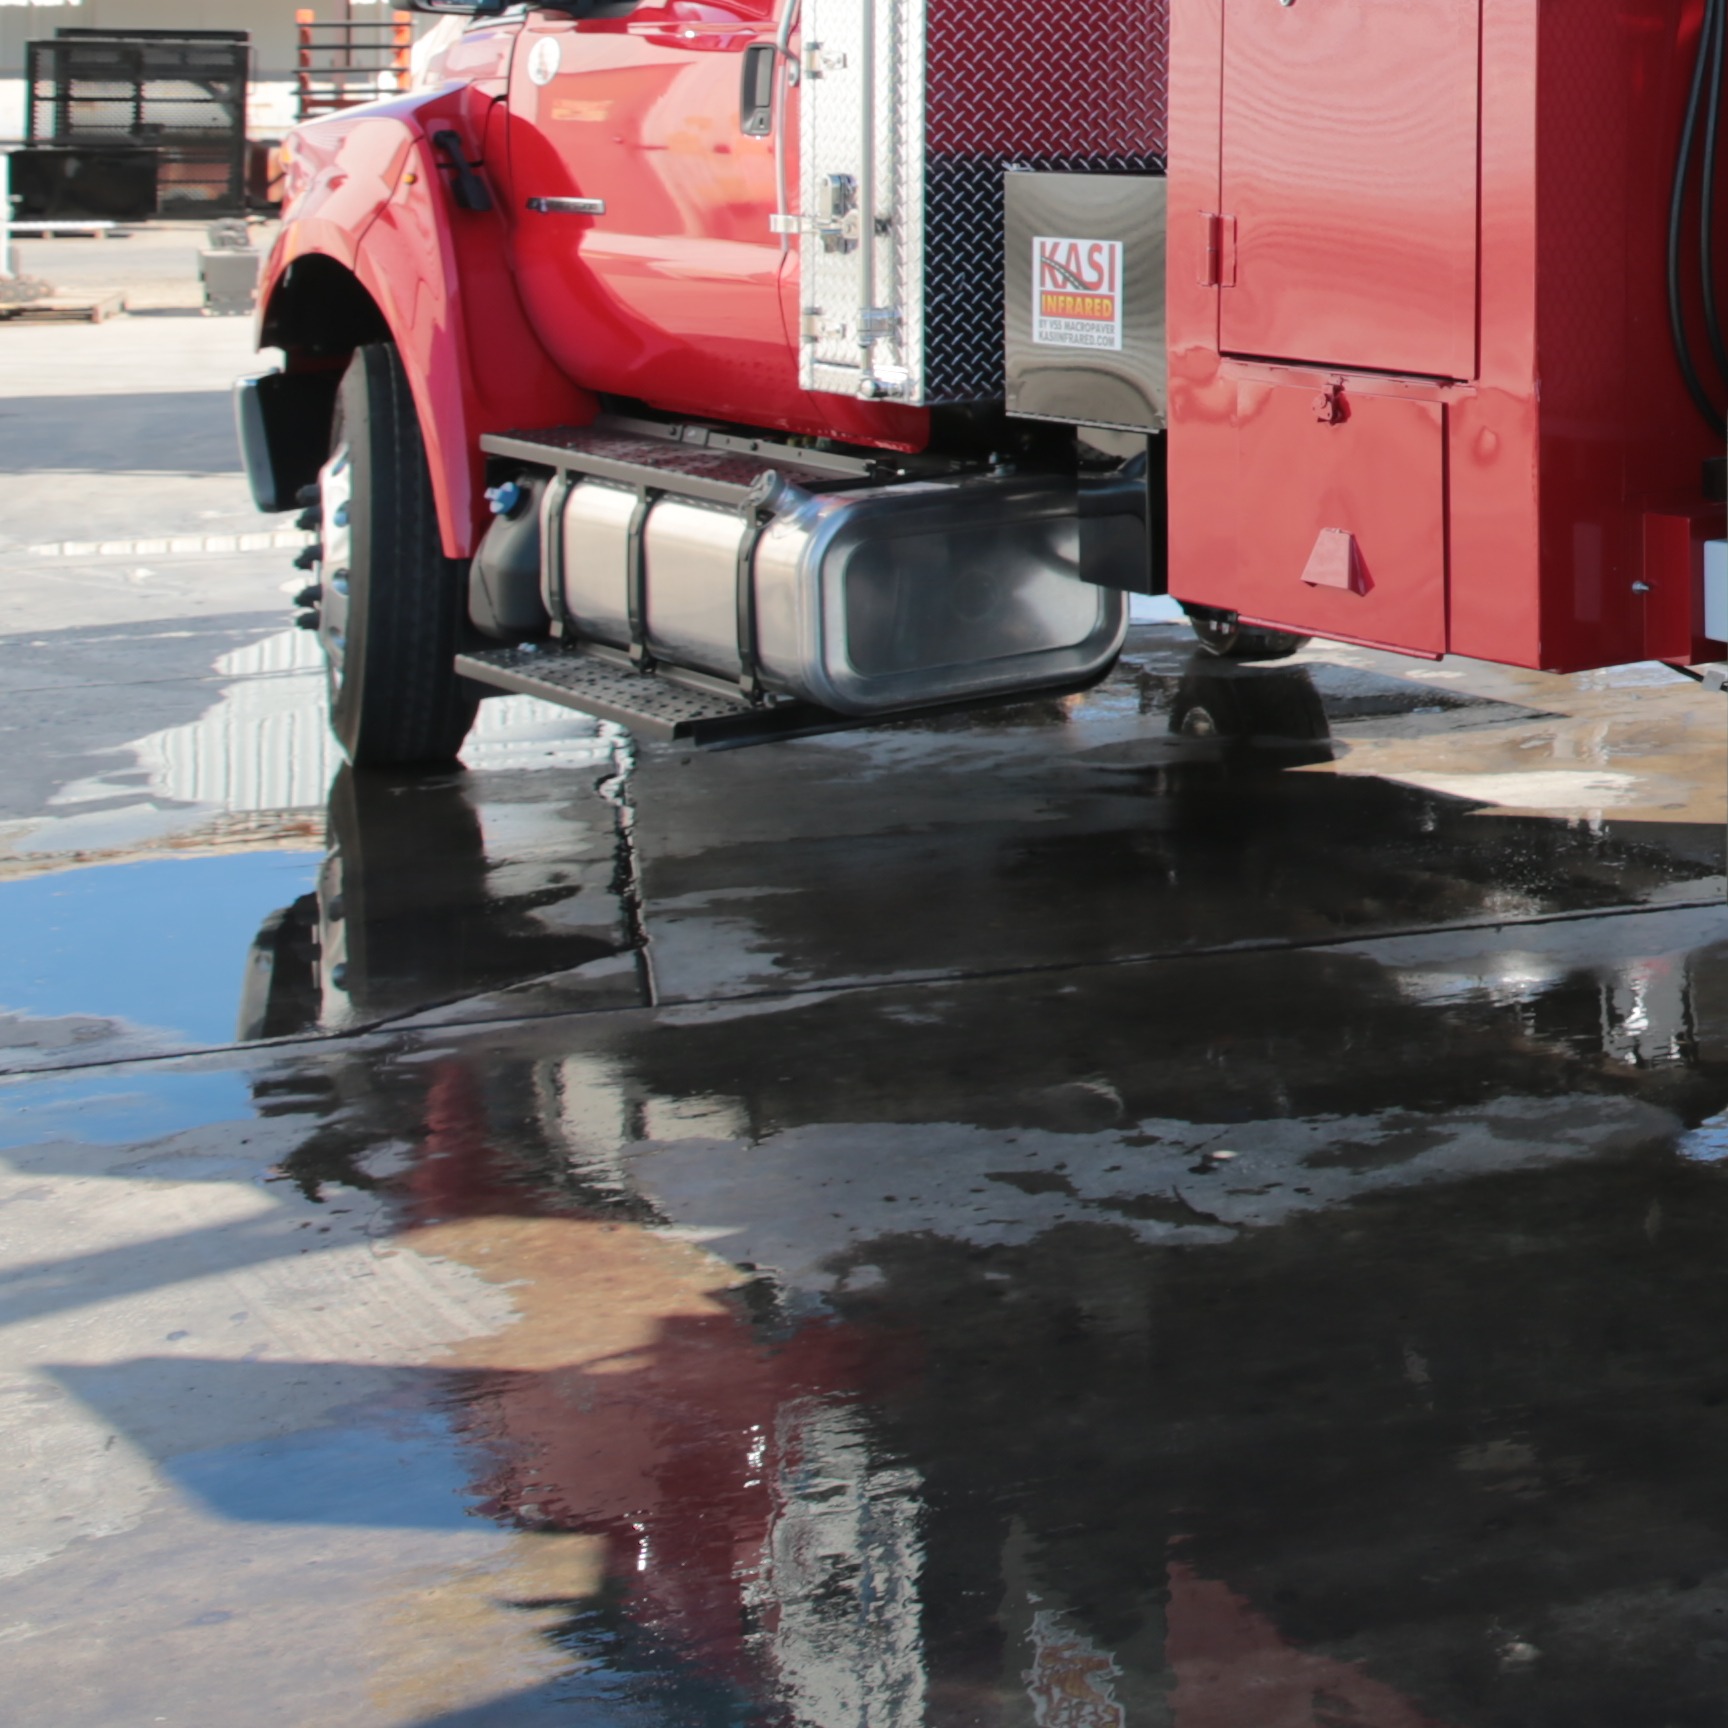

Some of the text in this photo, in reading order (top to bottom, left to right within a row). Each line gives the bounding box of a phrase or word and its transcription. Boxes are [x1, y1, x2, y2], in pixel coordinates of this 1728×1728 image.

[1040, 241, 1116, 292] KASI
[1042, 294, 1113, 317] INFRARED
[1039, 319, 1115, 335] BY VSS MACROPAVER
[1039, 331, 1115, 347] KASIINFRARED.COM
